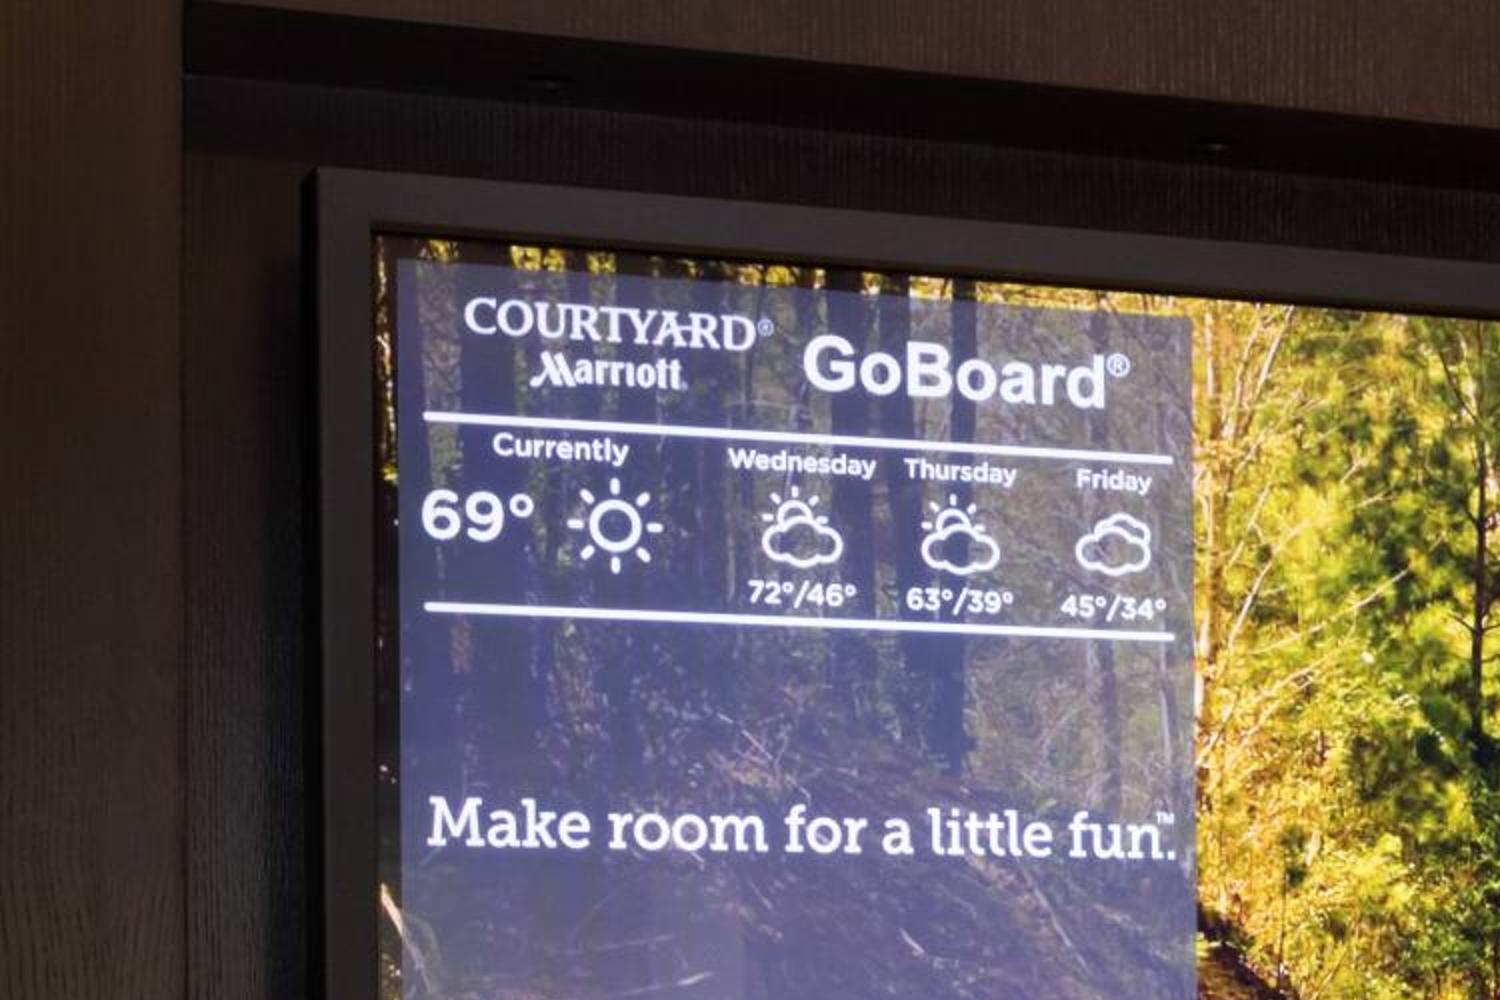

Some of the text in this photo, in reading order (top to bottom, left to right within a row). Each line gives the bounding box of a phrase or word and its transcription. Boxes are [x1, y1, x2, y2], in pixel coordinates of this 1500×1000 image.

[494, 432, 628, 466] Currently
[728, 448, 876, 479] Wednesday
[904, 458, 1017, 488] Thursday
[1077, 468, 1152, 495] Friday
[422, 489, 534, 541] 69°
[749, 580, 856, 608] 72°/46°
[907, 588, 1013, 614] 63°/39°
[1061, 594, 1166, 621] 45°/34°
[428, 796, 590, 848] Make
[608, 806, 768, 851] room
[785, 804, 867, 853] for
[882, 819, 914, 854] a
[928, 808, 1052, 857] little
